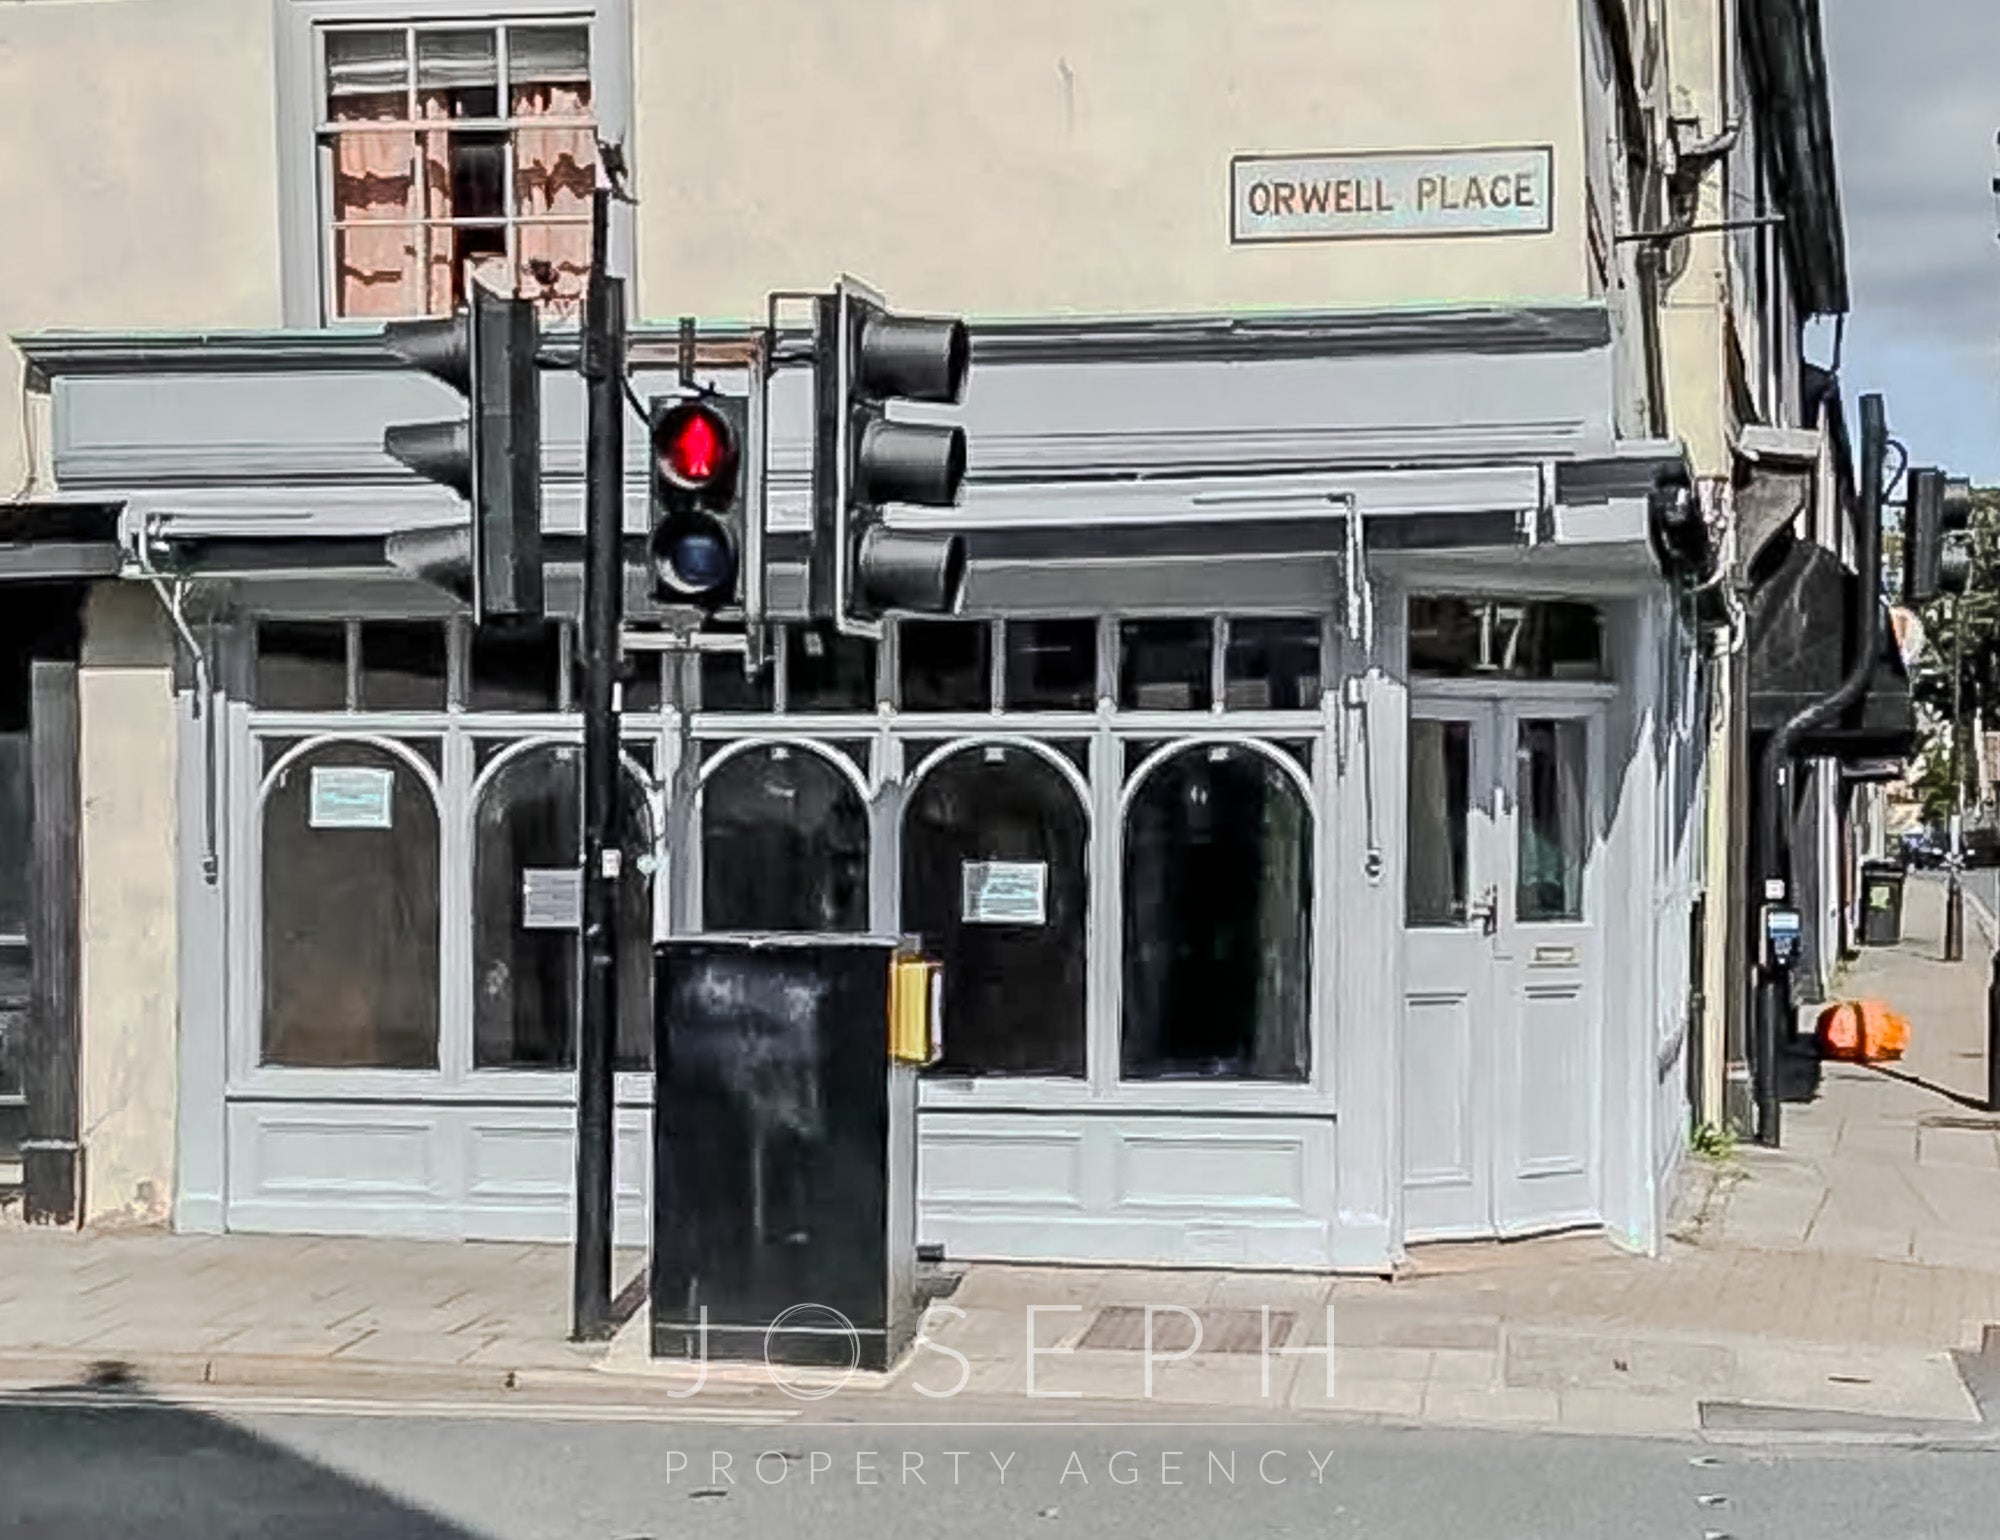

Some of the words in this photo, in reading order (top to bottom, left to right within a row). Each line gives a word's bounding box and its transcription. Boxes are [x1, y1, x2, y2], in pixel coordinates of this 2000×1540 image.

[1248, 179, 1393, 216] ORWELL
[1417, 174, 1535, 211] PLACE
[1470, 602, 1526, 671] 17
